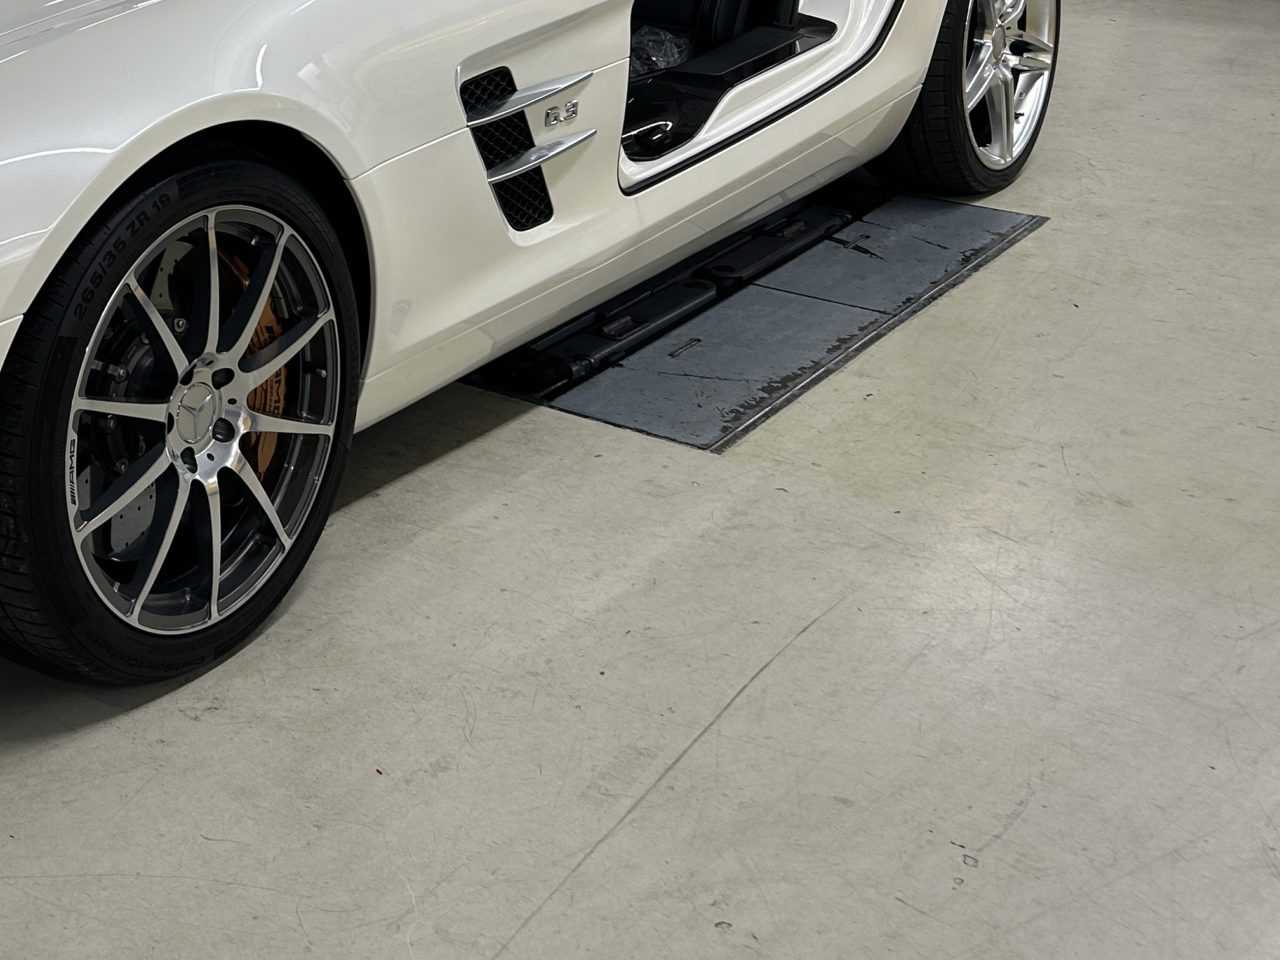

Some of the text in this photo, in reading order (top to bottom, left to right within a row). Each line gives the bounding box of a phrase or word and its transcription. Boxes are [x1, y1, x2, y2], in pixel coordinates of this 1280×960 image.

[544, 99, 579, 128] 6.3
[73, 193, 170, 322] 265/35 ZR 19
